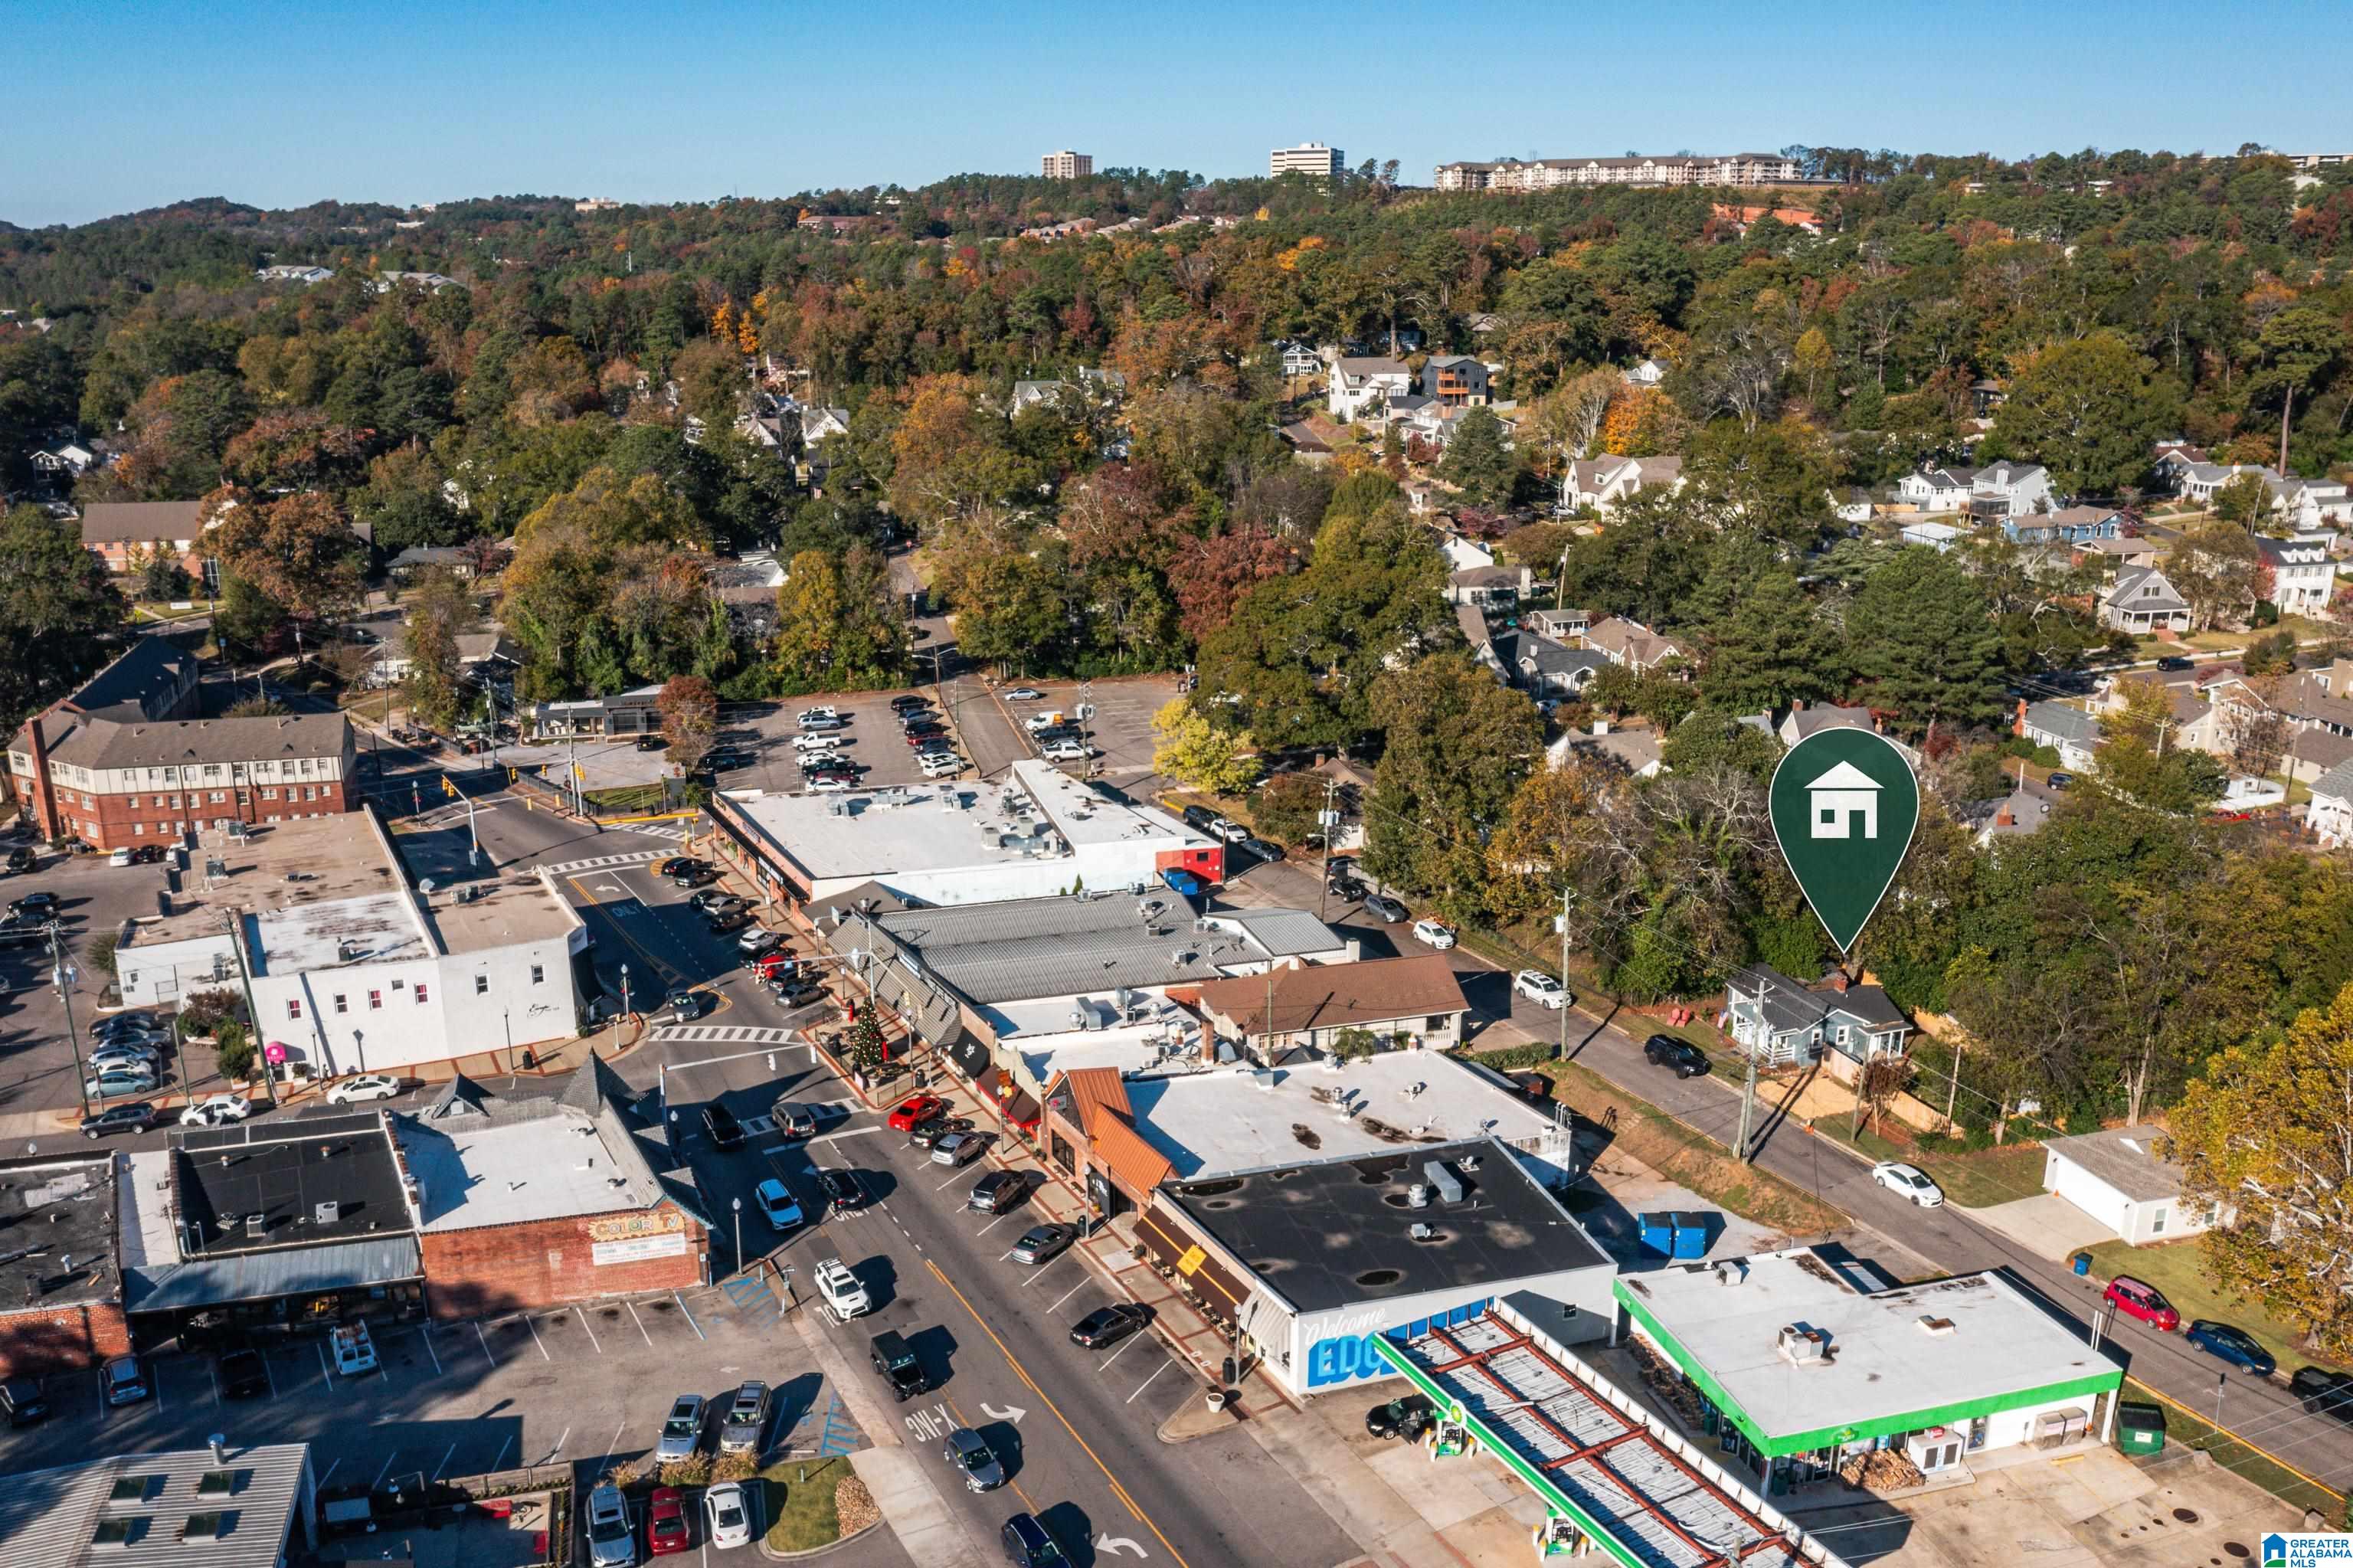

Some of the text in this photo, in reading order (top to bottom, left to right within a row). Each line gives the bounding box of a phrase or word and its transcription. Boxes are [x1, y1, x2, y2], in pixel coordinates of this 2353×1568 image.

[596, 1213, 679, 1236] COLOR TV
[1303, 1308, 1386, 1347] Welcome
[905, 1403, 960, 1442] X-ING
